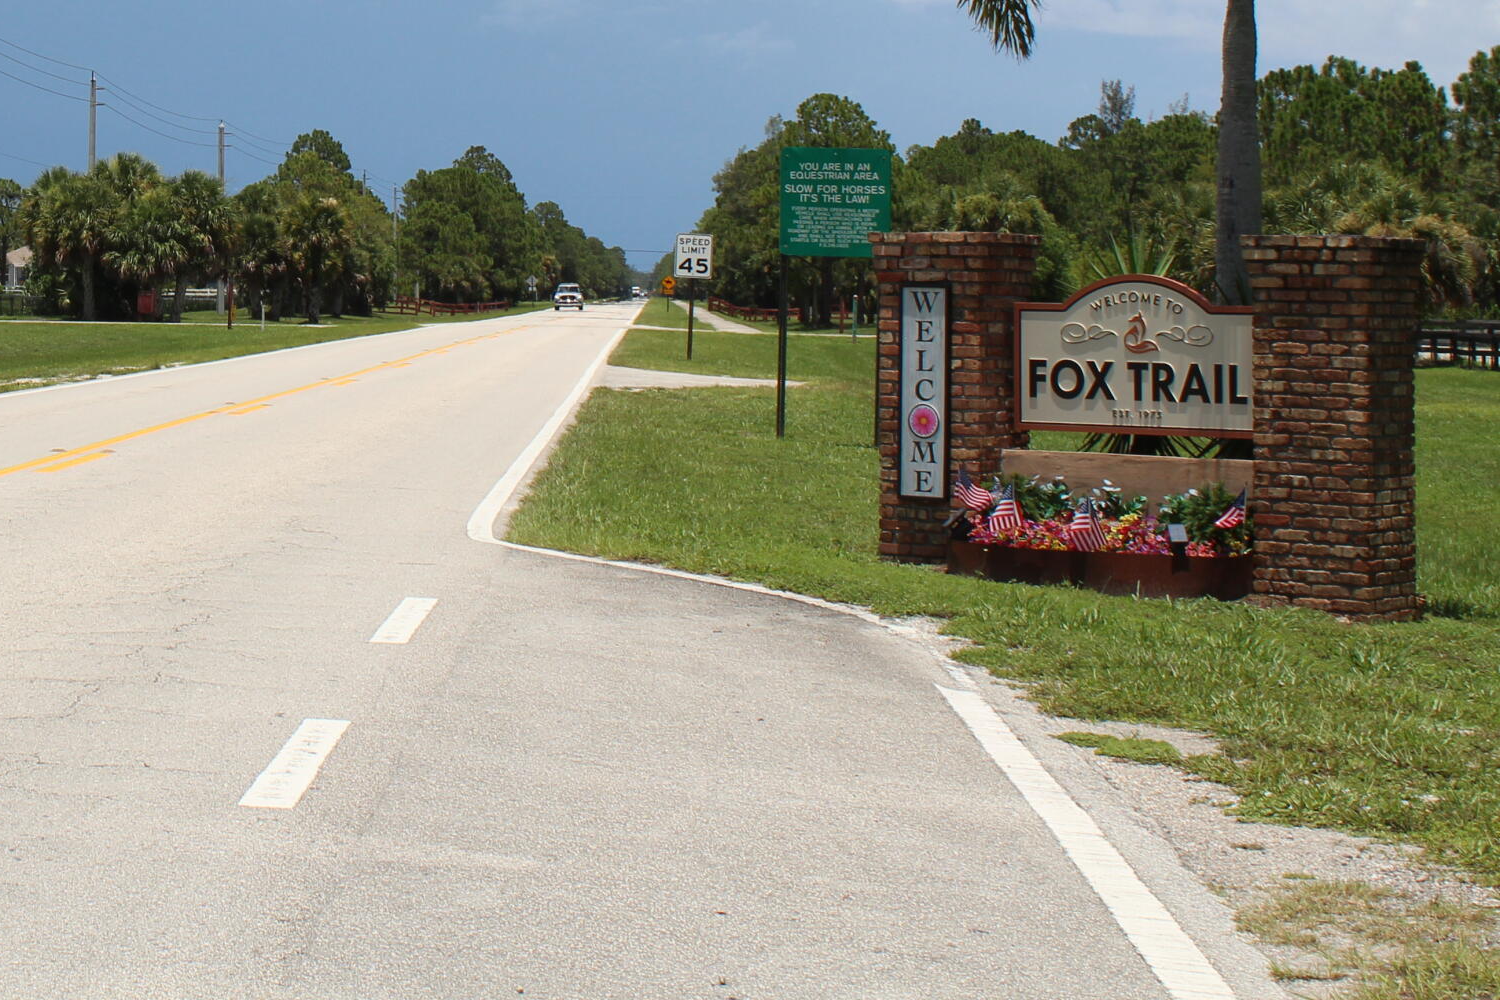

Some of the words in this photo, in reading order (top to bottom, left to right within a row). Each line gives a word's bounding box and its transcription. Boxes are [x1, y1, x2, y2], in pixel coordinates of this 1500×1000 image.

[799, 162, 819, 171] YOU
[822, 162, 841, 171] ARE
[844, 163, 854, 171] IN
[857, 163, 870, 171] AN
[789, 171, 850, 180] EQUESTRIAN
[853, 172, 879, 180] AREA
[784, 184, 813, 193] SLOW
[817, 184, 838, 194] FOR
[841, 185, 886, 195] HORSES
[799, 193, 818, 203] IT'S
[821, 194, 842, 203] THE
[845, 195, 870, 204] LAW!
[679, 237, 710, 246] SPEED
[681, 246, 707, 254] LIMIT
[678, 257, 709, 274] 45
[1089, 291, 1161, 311] WELCOME
[1166, 299, 1184, 315] TO
[1028, 358, 1116, 400] FOX
[1126, 361, 1249, 405] TRAIL
